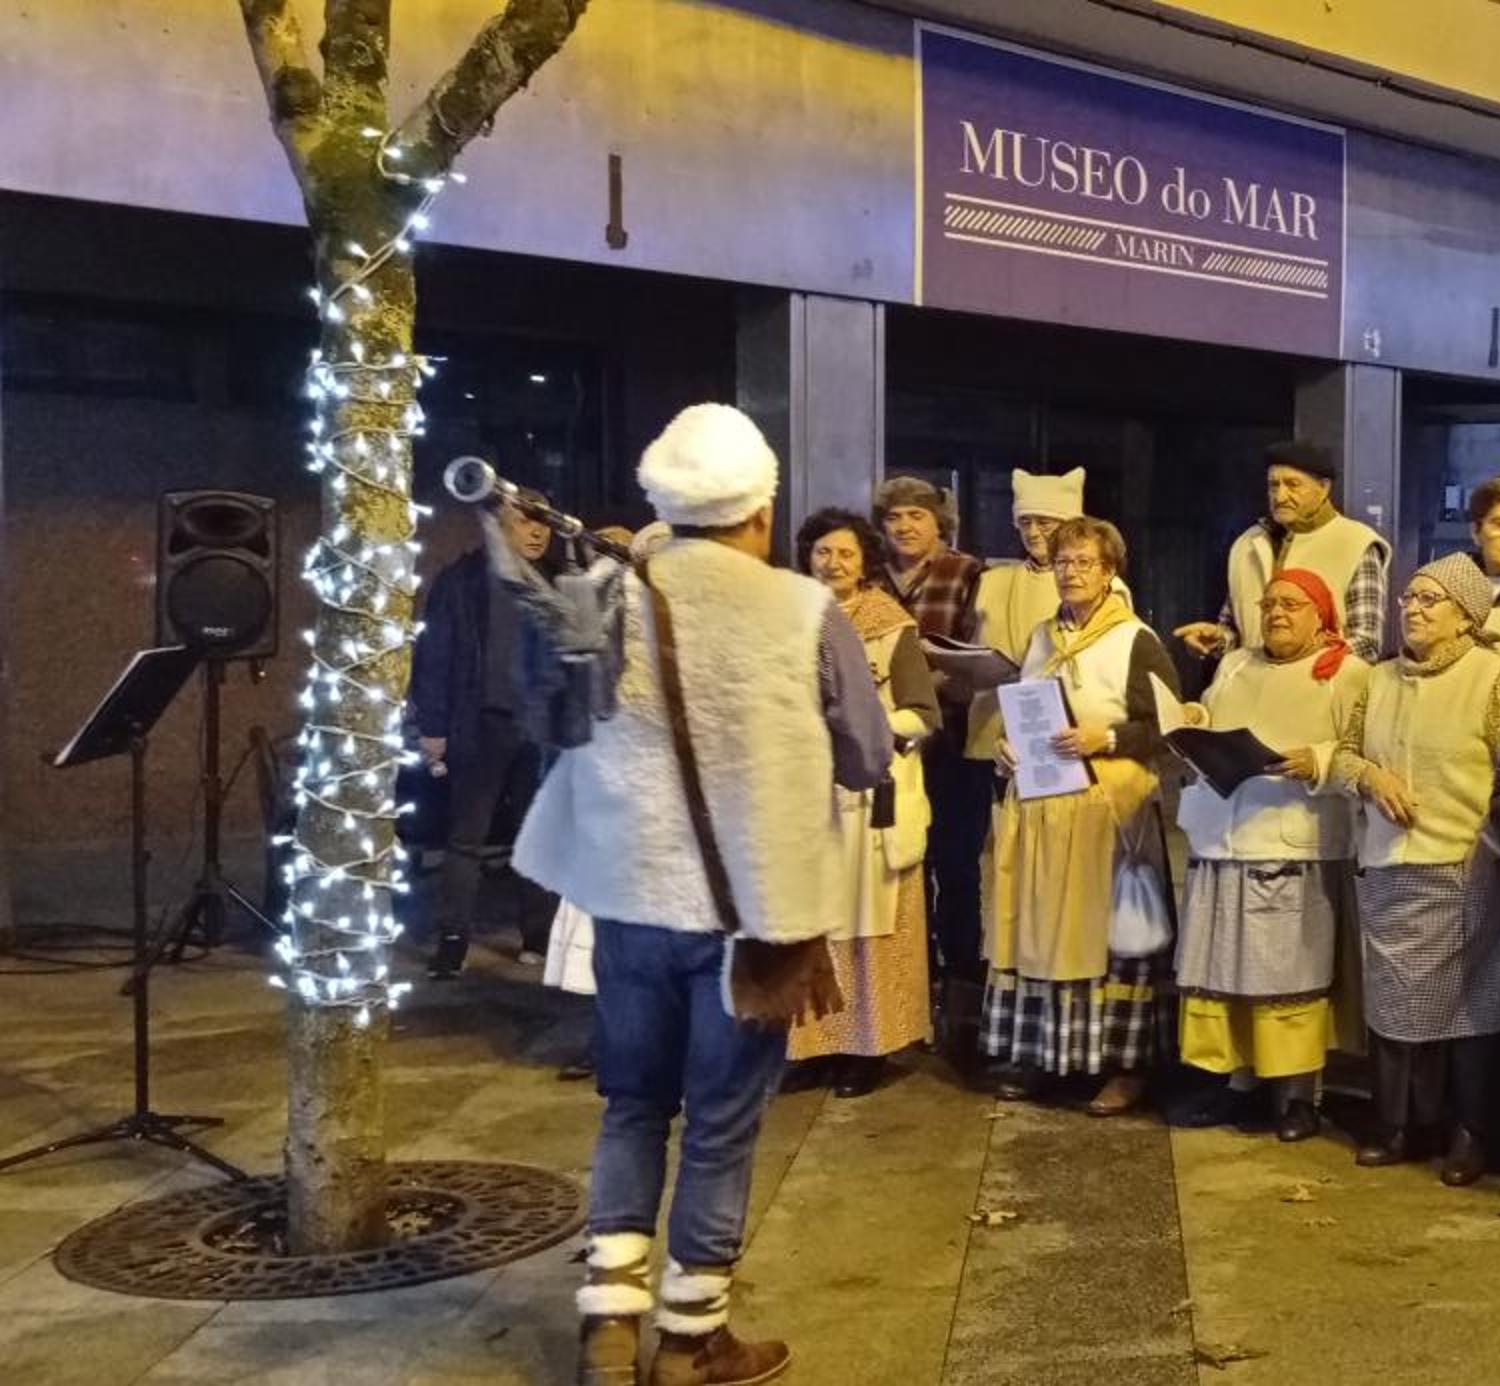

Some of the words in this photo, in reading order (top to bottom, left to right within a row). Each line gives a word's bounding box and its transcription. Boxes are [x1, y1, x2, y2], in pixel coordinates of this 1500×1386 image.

[959, 120, 1149, 206] MUSEO
[1161, 167, 1211, 220] do
[1221, 177, 1319, 241] MAR
[1115, 233, 1195, 266] MARIN
